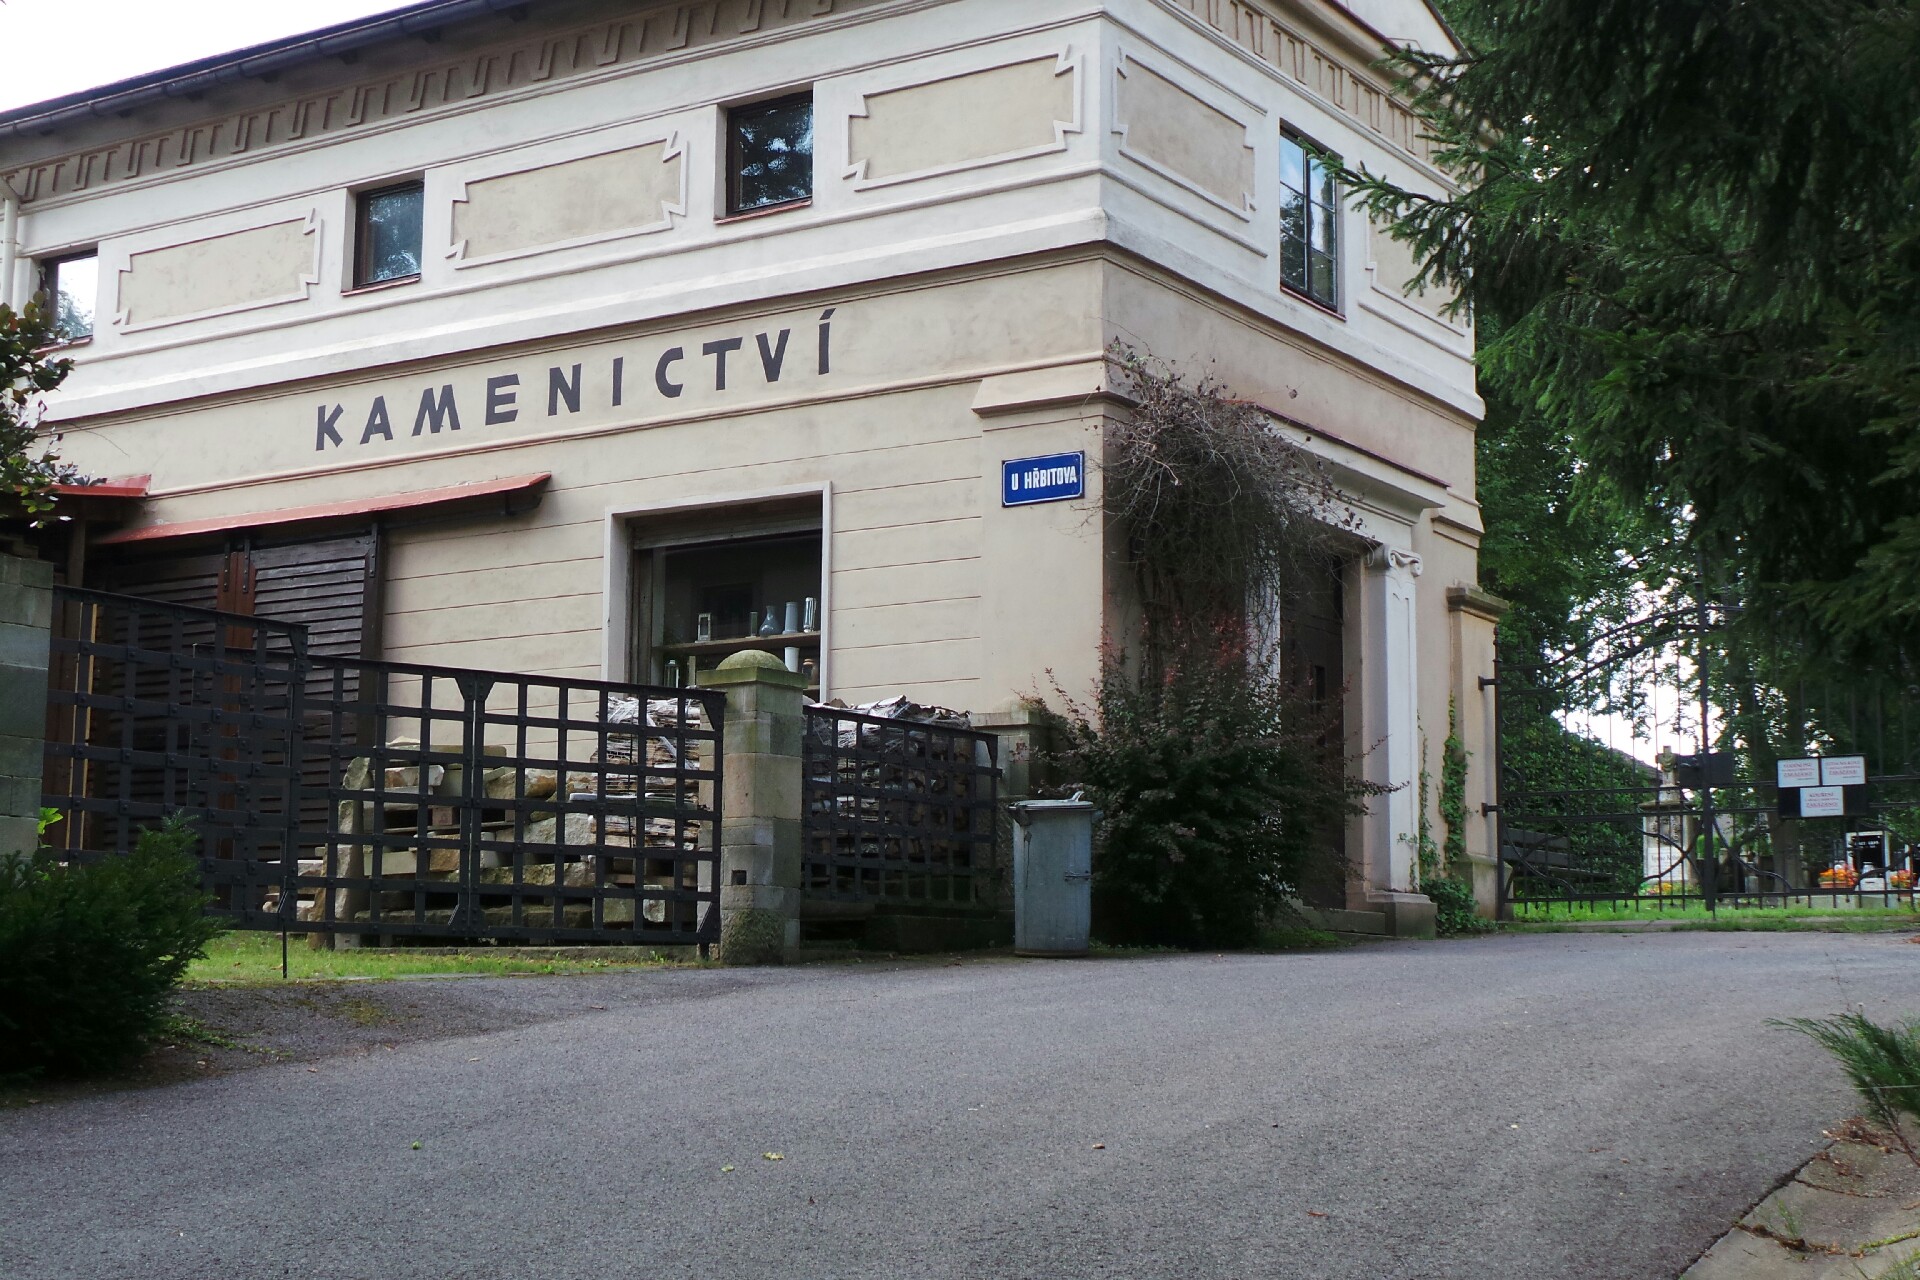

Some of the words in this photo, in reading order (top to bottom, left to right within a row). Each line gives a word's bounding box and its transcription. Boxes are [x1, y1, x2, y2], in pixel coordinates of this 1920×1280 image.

[316, 308, 836, 451] KAMENICTVÍ
[1011, 473, 1019, 491] U
[1024, 466, 1077, 489] HŘBITOVA
